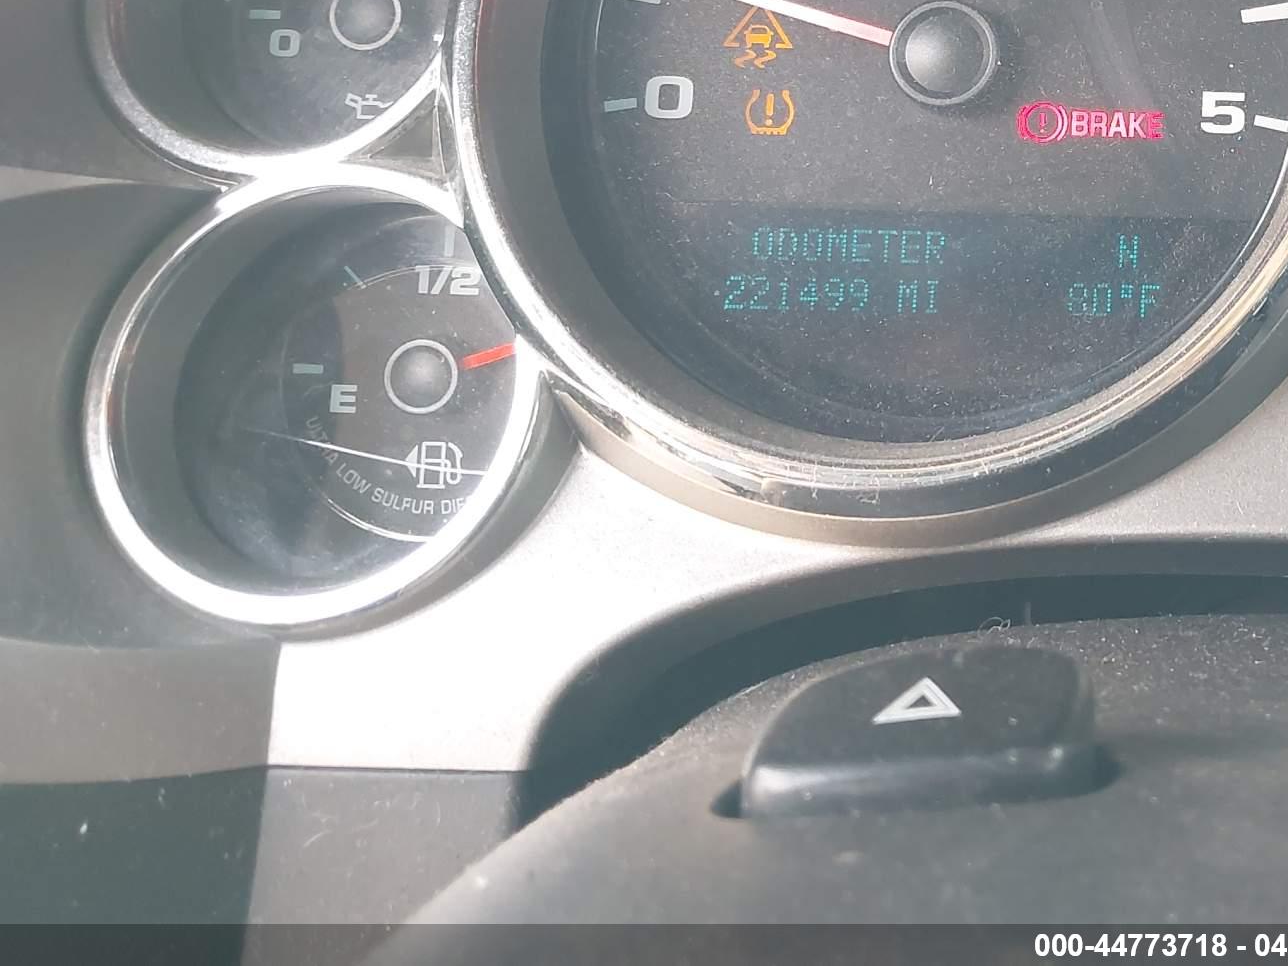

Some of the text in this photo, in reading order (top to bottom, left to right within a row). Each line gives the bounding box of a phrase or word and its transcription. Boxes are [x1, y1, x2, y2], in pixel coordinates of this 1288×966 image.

[269, 29, 300, 57] 0
[644, 76, 694, 120] 0
[1200, 92, 1246, 134] 5
[1070, 110, 1165, 139] BRAKE
[751, 226, 946, 264] ODOMETER
[1119, 234, 1139, 268] N
[415, 265, 481, 296] 1/2
[723, 275, 939, 313] 221499 MI
[329, 384, 358, 414] E
[336, 462, 372, 494] LOW
[371, 488, 435, 515] SULFUR
